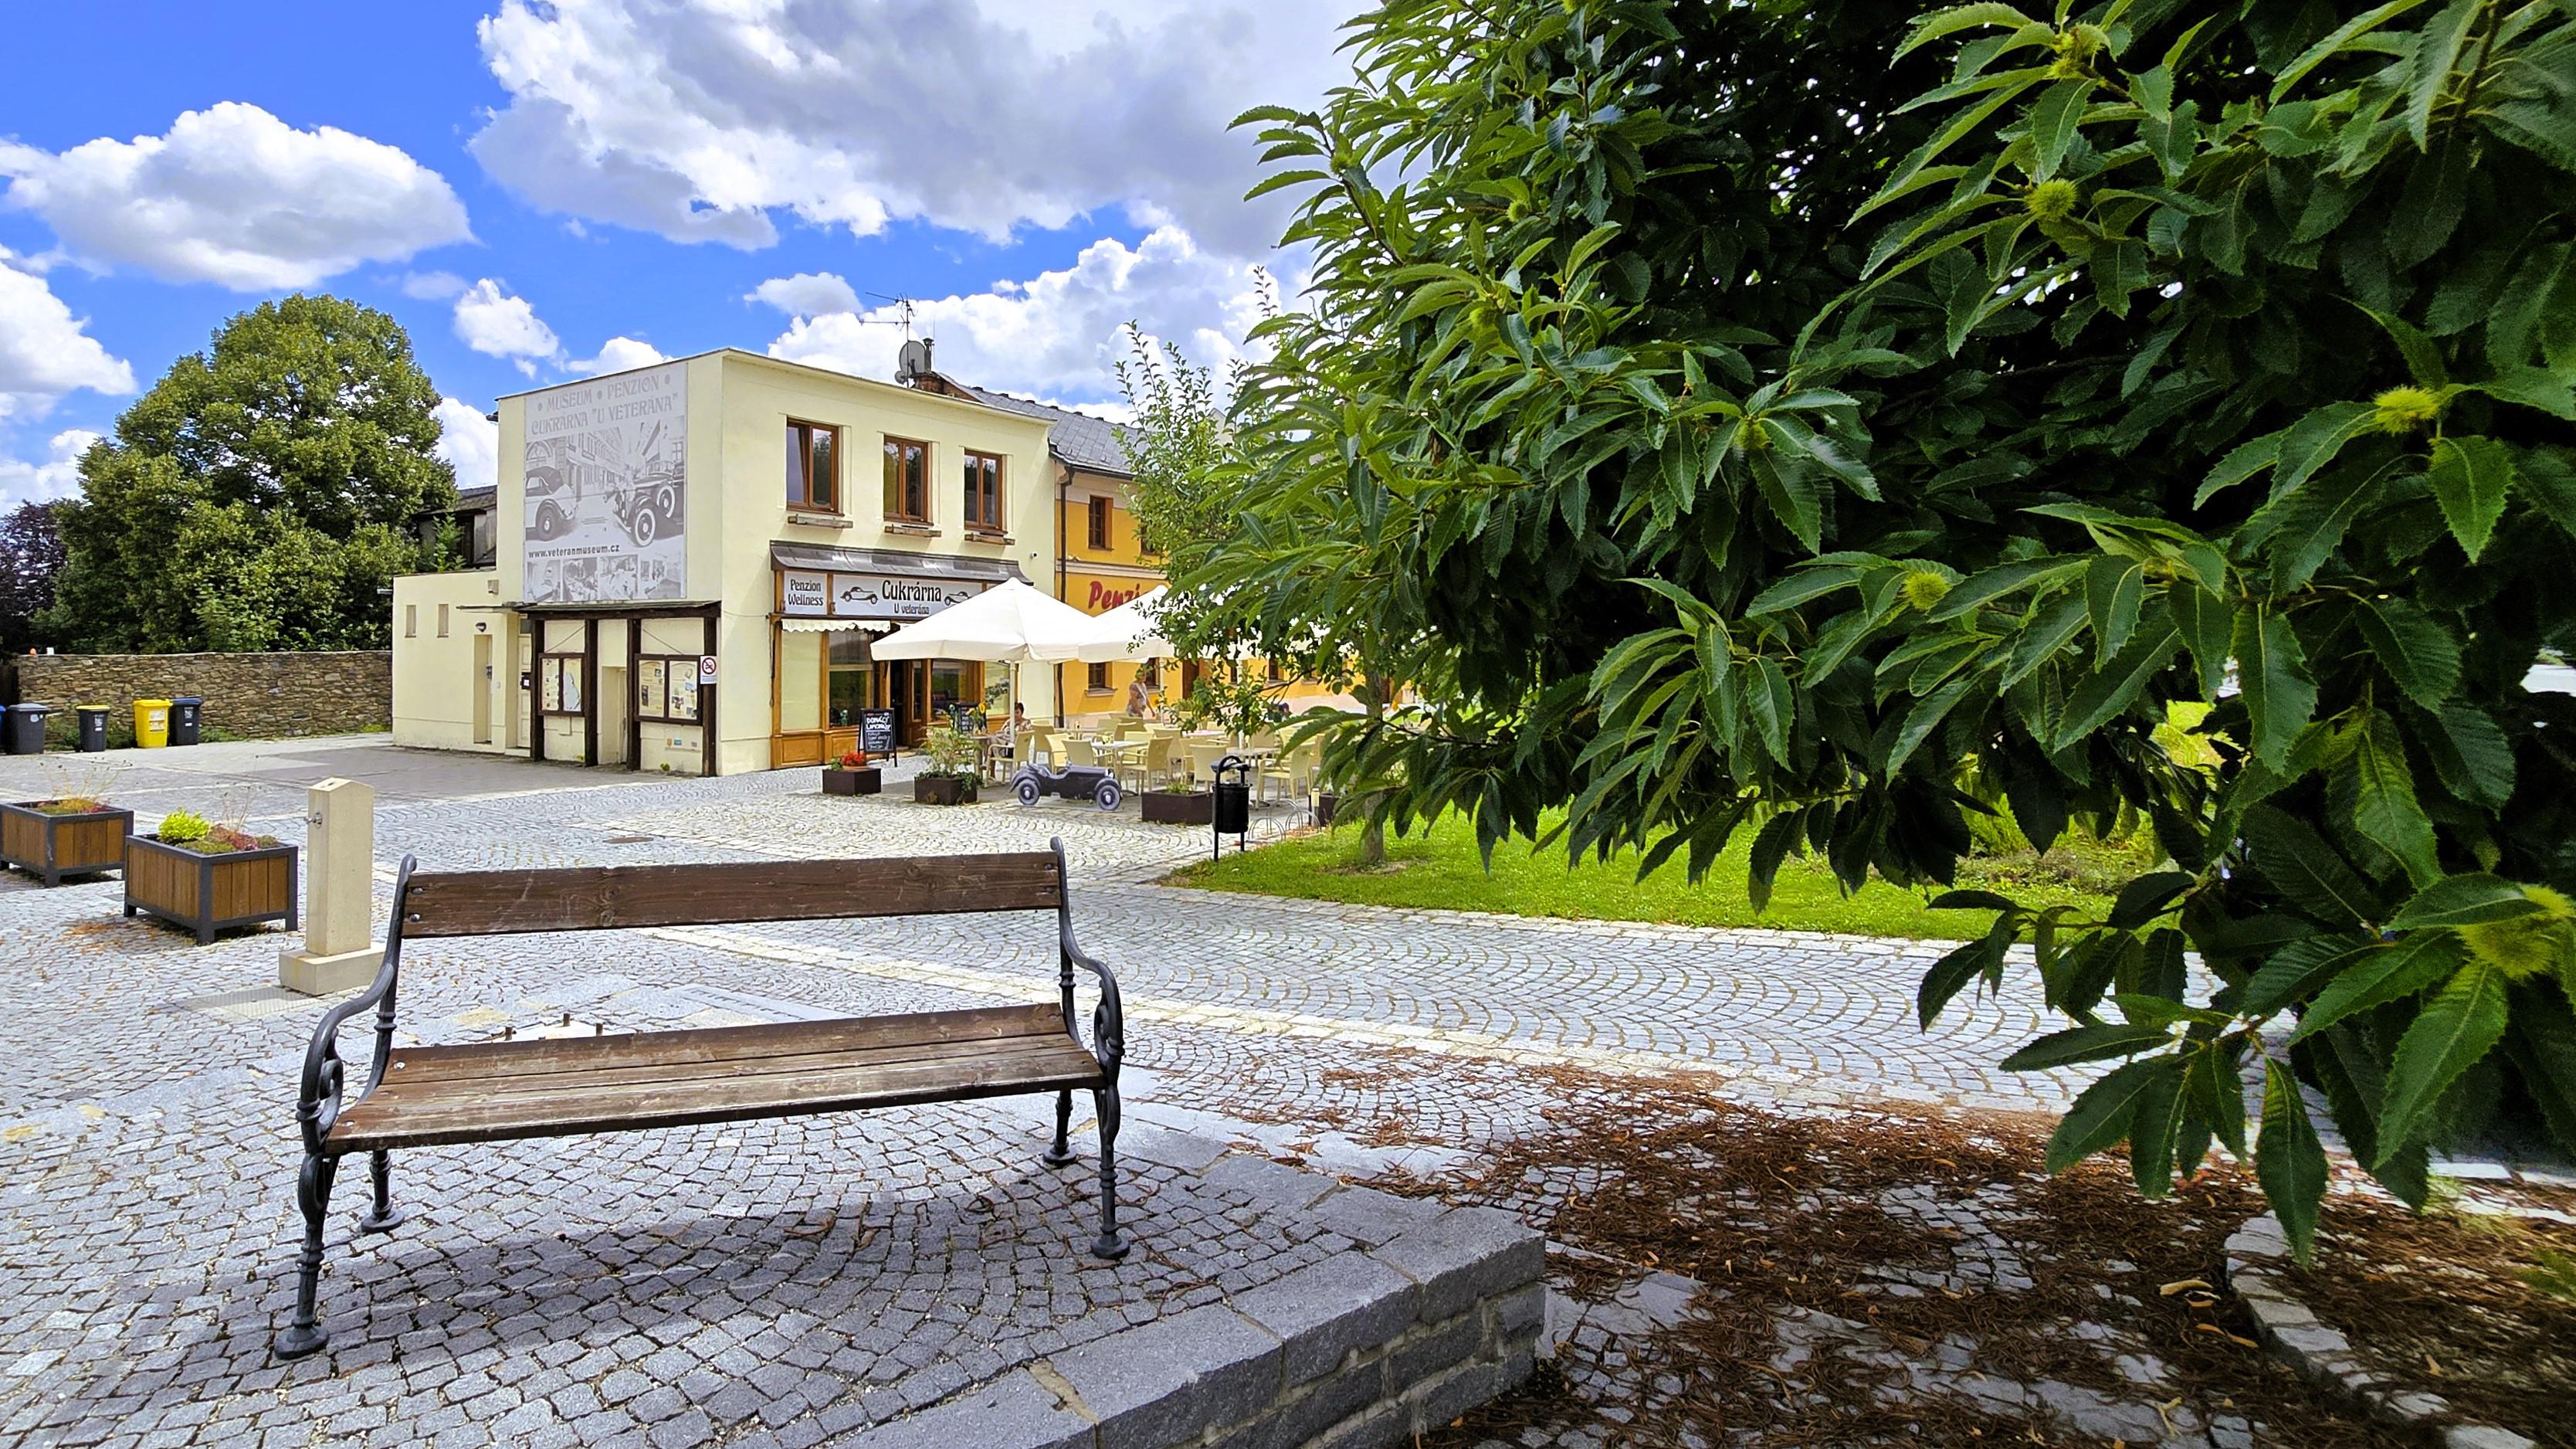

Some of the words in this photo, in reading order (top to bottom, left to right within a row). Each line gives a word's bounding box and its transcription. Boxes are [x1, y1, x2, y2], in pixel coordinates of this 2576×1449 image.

[546, 389, 592, 412] MUSEUM
[608, 374, 659, 399] PENZION
[528, 545, 620, 558] www.veteranmuseum.cz
[790, 579, 822, 592] Penzion
[882, 580, 942, 602] Cukrárna
[788, 593, 824, 606] Wellness
[1088, 580, 1149, 609] Penzi
[893, 603, 900, 614] U
[901, 603, 930, 614] veterána
